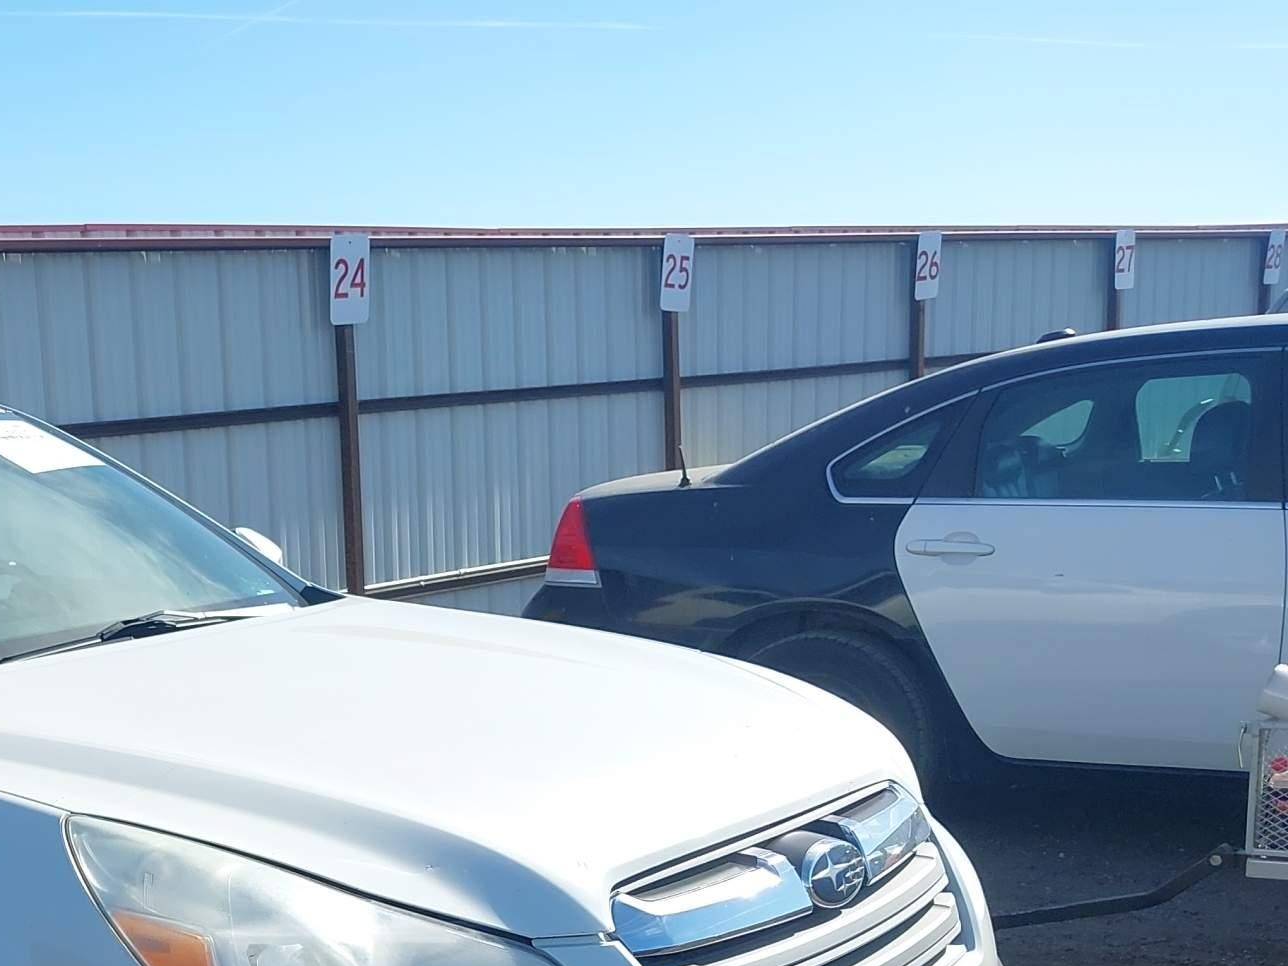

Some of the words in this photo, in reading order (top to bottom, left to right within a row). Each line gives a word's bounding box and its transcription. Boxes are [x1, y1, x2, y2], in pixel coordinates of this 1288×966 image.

[663, 254, 690, 289] 25
[915, 250, 939, 281] 26
[1114, 246, 1135, 274] 27
[1266, 244, 1283, 270] 28
[333, 259, 366, 299] 24
